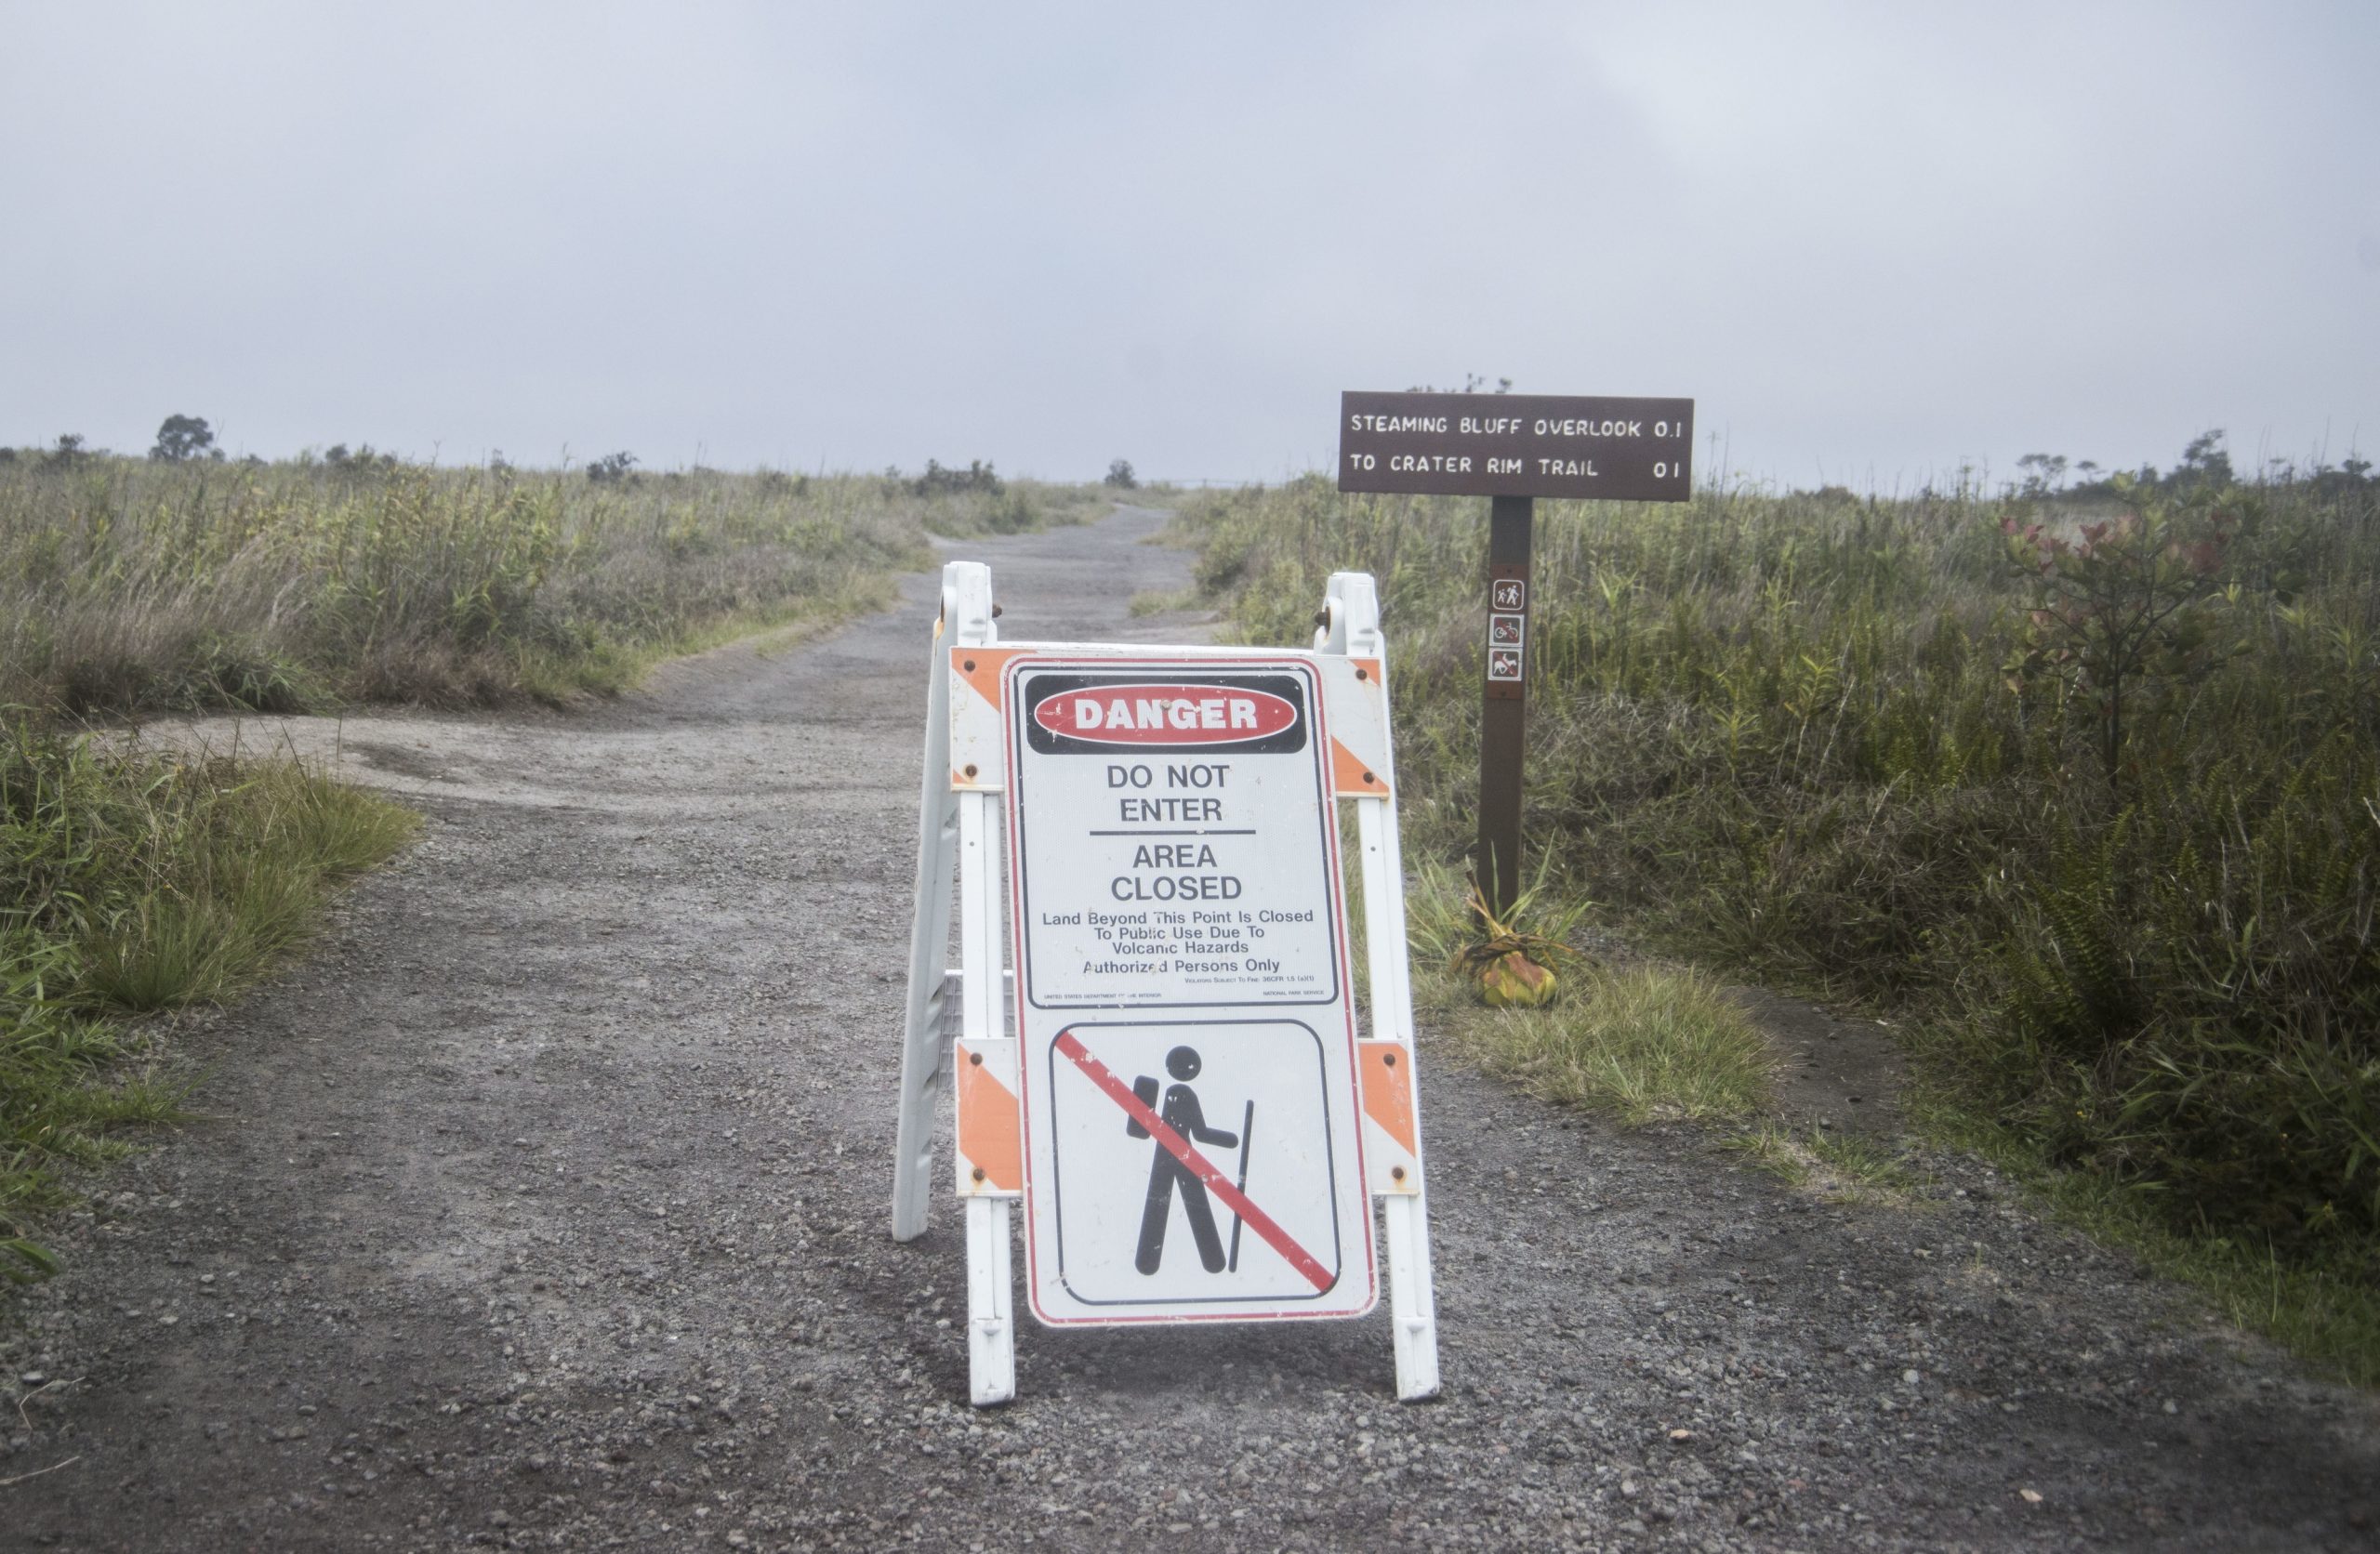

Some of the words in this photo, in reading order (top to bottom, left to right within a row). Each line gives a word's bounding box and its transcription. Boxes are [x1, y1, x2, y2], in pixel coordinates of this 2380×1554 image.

[1351, 415, 1448, 432] STEAMING
[1460, 417, 1523, 434] BLUFF
[1534, 419, 1641, 437] OVERLOOK
[1654, 420, 1681, 438] 0.1
[1350, 454, 1376, 471] TO
[1390, 455, 1472, 473] CRATER
[1488, 458, 1523, 475] RIM
[1539, 459, 1599, 477] TRAIL
[1075, 698, 1258, 730] DANGER
[1107, 765, 1153, 788] DO
[1168, 765, 1230, 788] NOT
[1120, 798, 1223, 822] ENTER
[1132, 845, 1218, 868] AREA
[1111, 876, 1242, 902] CLOSED
[1042, 913, 1080, 925] Land
[1088, 912, 1147, 927] Beyond
[1153, 912, 1186, 924] This
[1193, 912, 1232, 924] Point
[1238, 911, 1251, 922] Is
[1259, 910, 1314, 922] Closed
[1094, 928, 1112, 940] To
[1119, 928, 1166, 940] Public
[1173, 927, 1203, 939] Use
[1210, 926, 1240, 938] Due
[1247, 926, 1265, 938] To
[1113, 942, 1178, 955] Volcanic
[1185, 941, 1249, 954] Hazards
[1083, 960, 1168, 974] Authorized
[1175, 960, 1238, 972] Persons
[1246, 958, 1280, 973] Only
